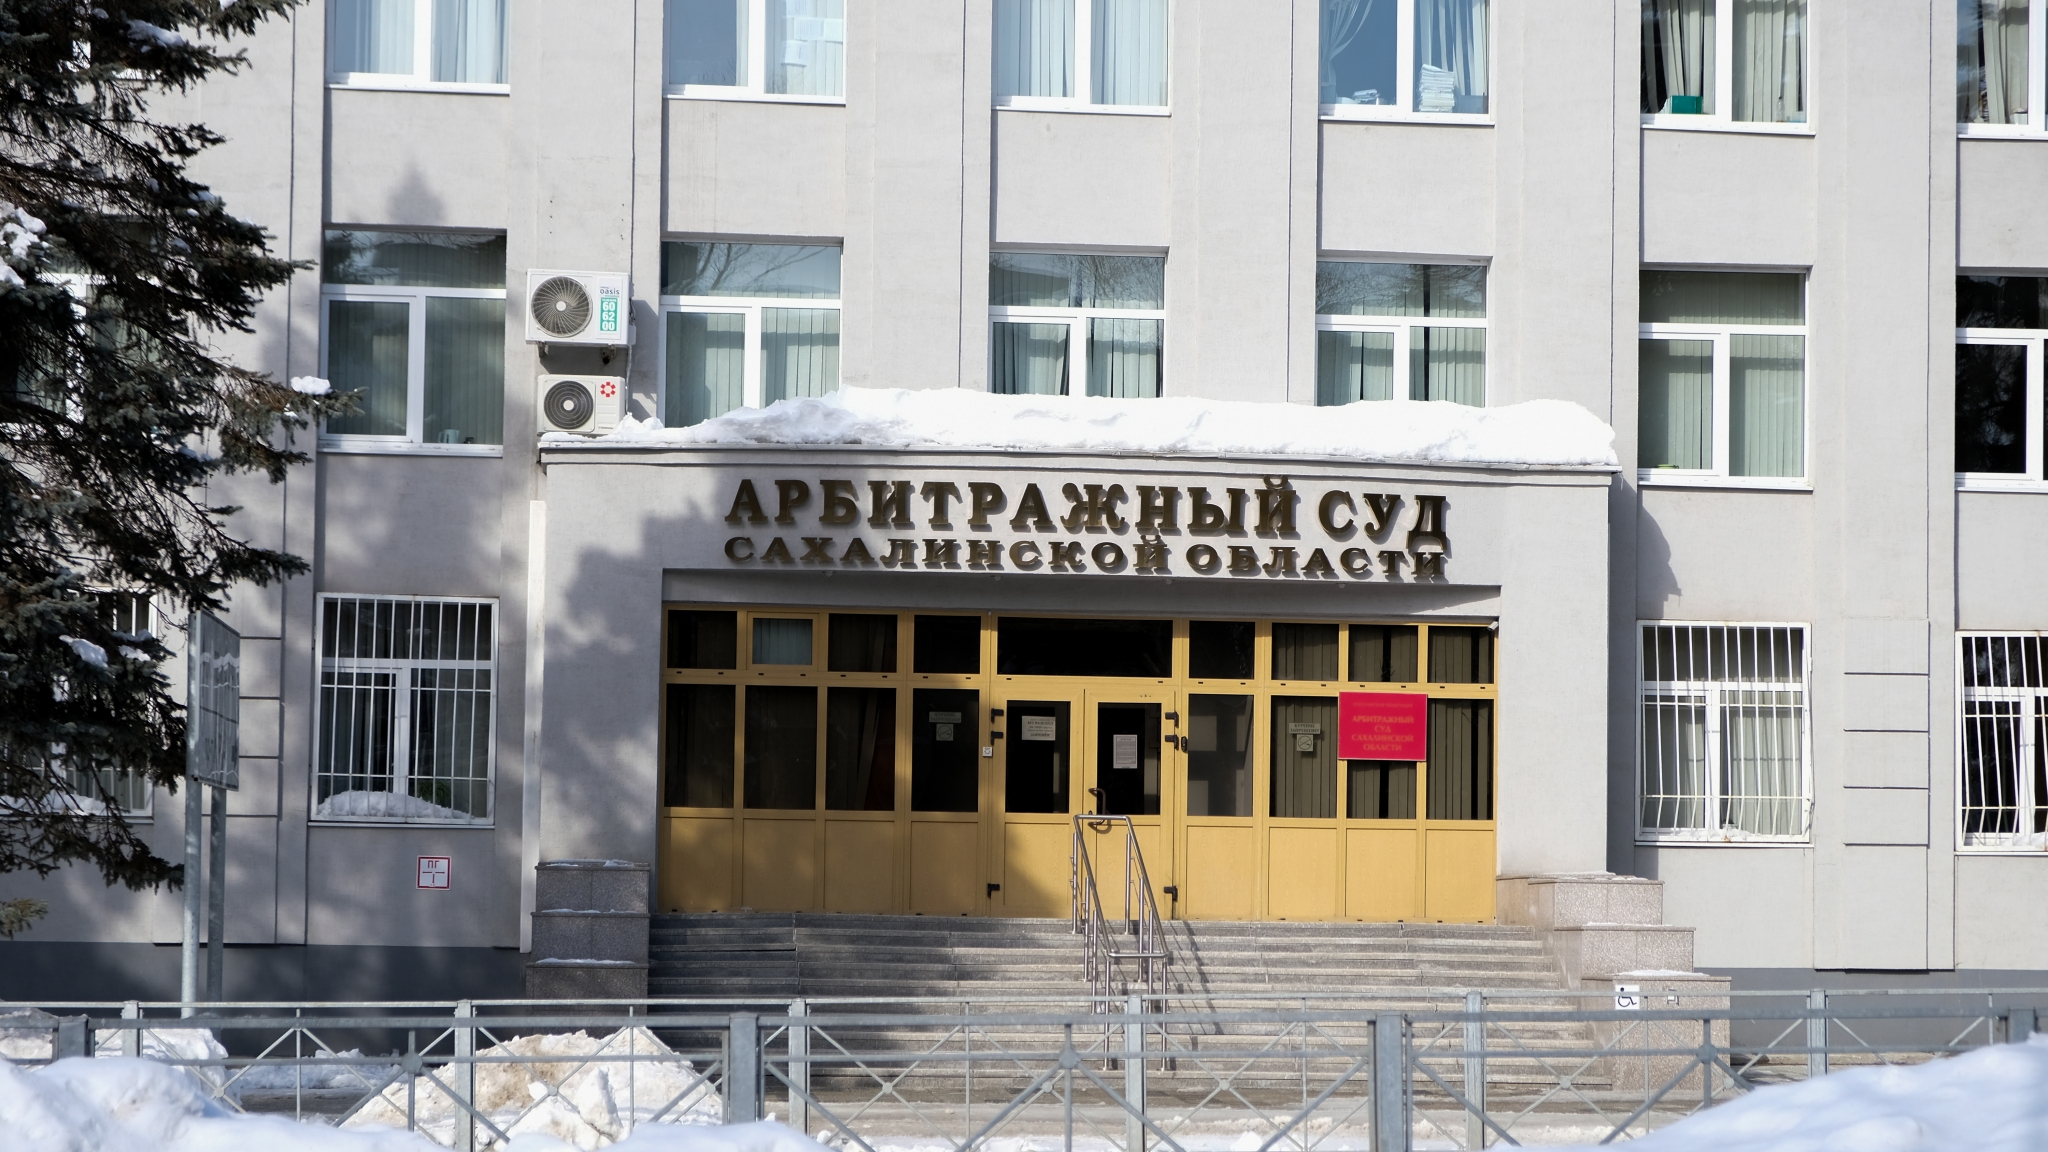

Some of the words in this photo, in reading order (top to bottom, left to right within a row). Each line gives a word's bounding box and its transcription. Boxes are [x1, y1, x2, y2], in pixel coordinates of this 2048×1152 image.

[602, 301, 616, 311] 60
[602, 311, 616, 321] 62
[602, 321, 616, 331] 00
[724, 475, 1297, 533] АРБИТРАЖНЫЙ
[1318, 490, 1448, 551] СУД
[724, 535, 1168, 572] САХАЛИНСКОЙ
[1185, 543, 1446, 577] ОБЛАСТИ
[1352, 715, 1414, 724] АРБИТРАЖНЫЙ
[1374, 725, 1391, 733] СУД
[1351, 734, 1414, 742] САХАЛИНСКОЙ
[1363, 743, 1402, 751] ОБЛАСТИ
[427, 860, 440, 869] ПГ
